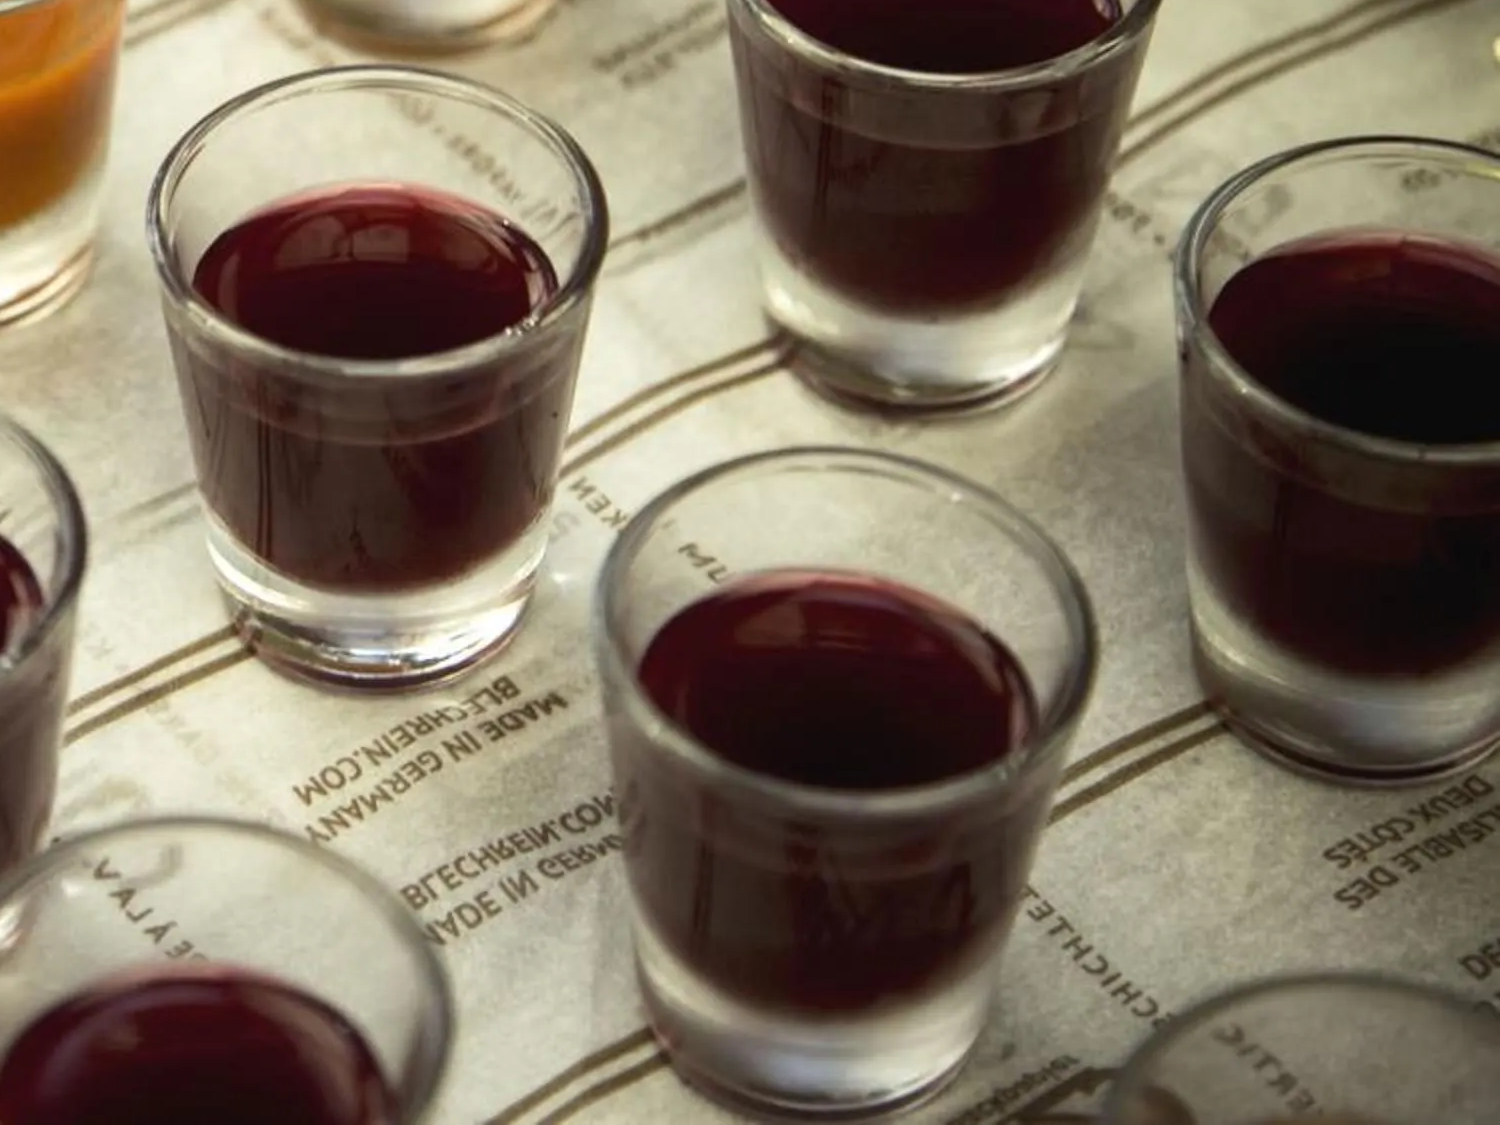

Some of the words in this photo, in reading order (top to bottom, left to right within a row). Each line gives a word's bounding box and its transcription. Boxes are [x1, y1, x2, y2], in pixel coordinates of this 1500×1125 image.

[290, 673, 522, 806] BLECHREIN.COM
[475, 689, 571, 745] MADE
[440, 728, 483, 763] IN
[301, 748, 444, 848] GERMANY
[1409, 772, 1495, 825] DEUX
[1392, 805, 1500, 879] LISABLE
[1331, 862, 1398, 911] DES
